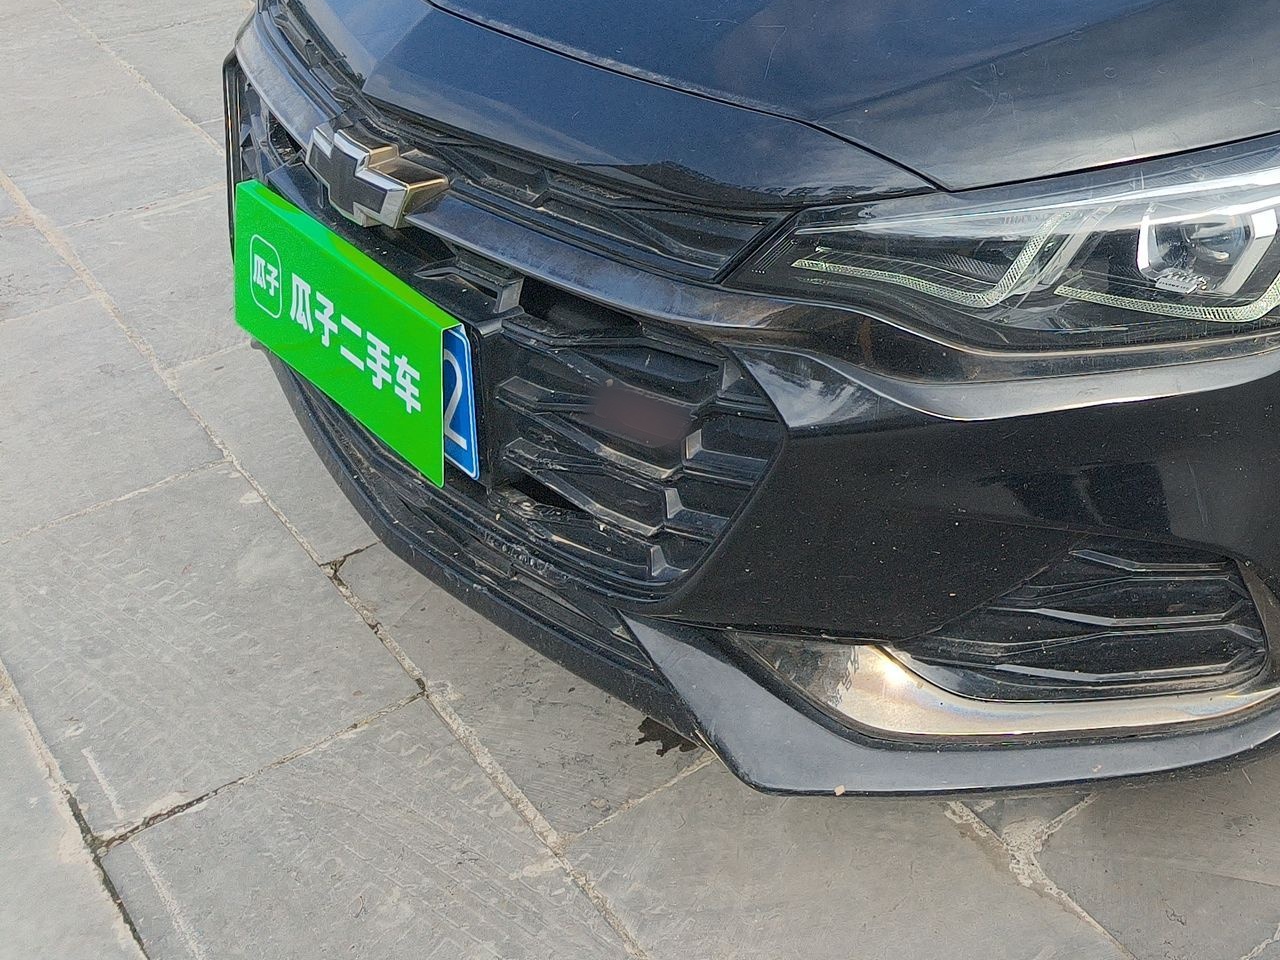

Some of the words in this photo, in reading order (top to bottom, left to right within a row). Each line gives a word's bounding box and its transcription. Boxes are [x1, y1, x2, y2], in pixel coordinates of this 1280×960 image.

[253, 255, 279, 296] 瓜子
[290, 273, 422, 414] 瓜子二手车
